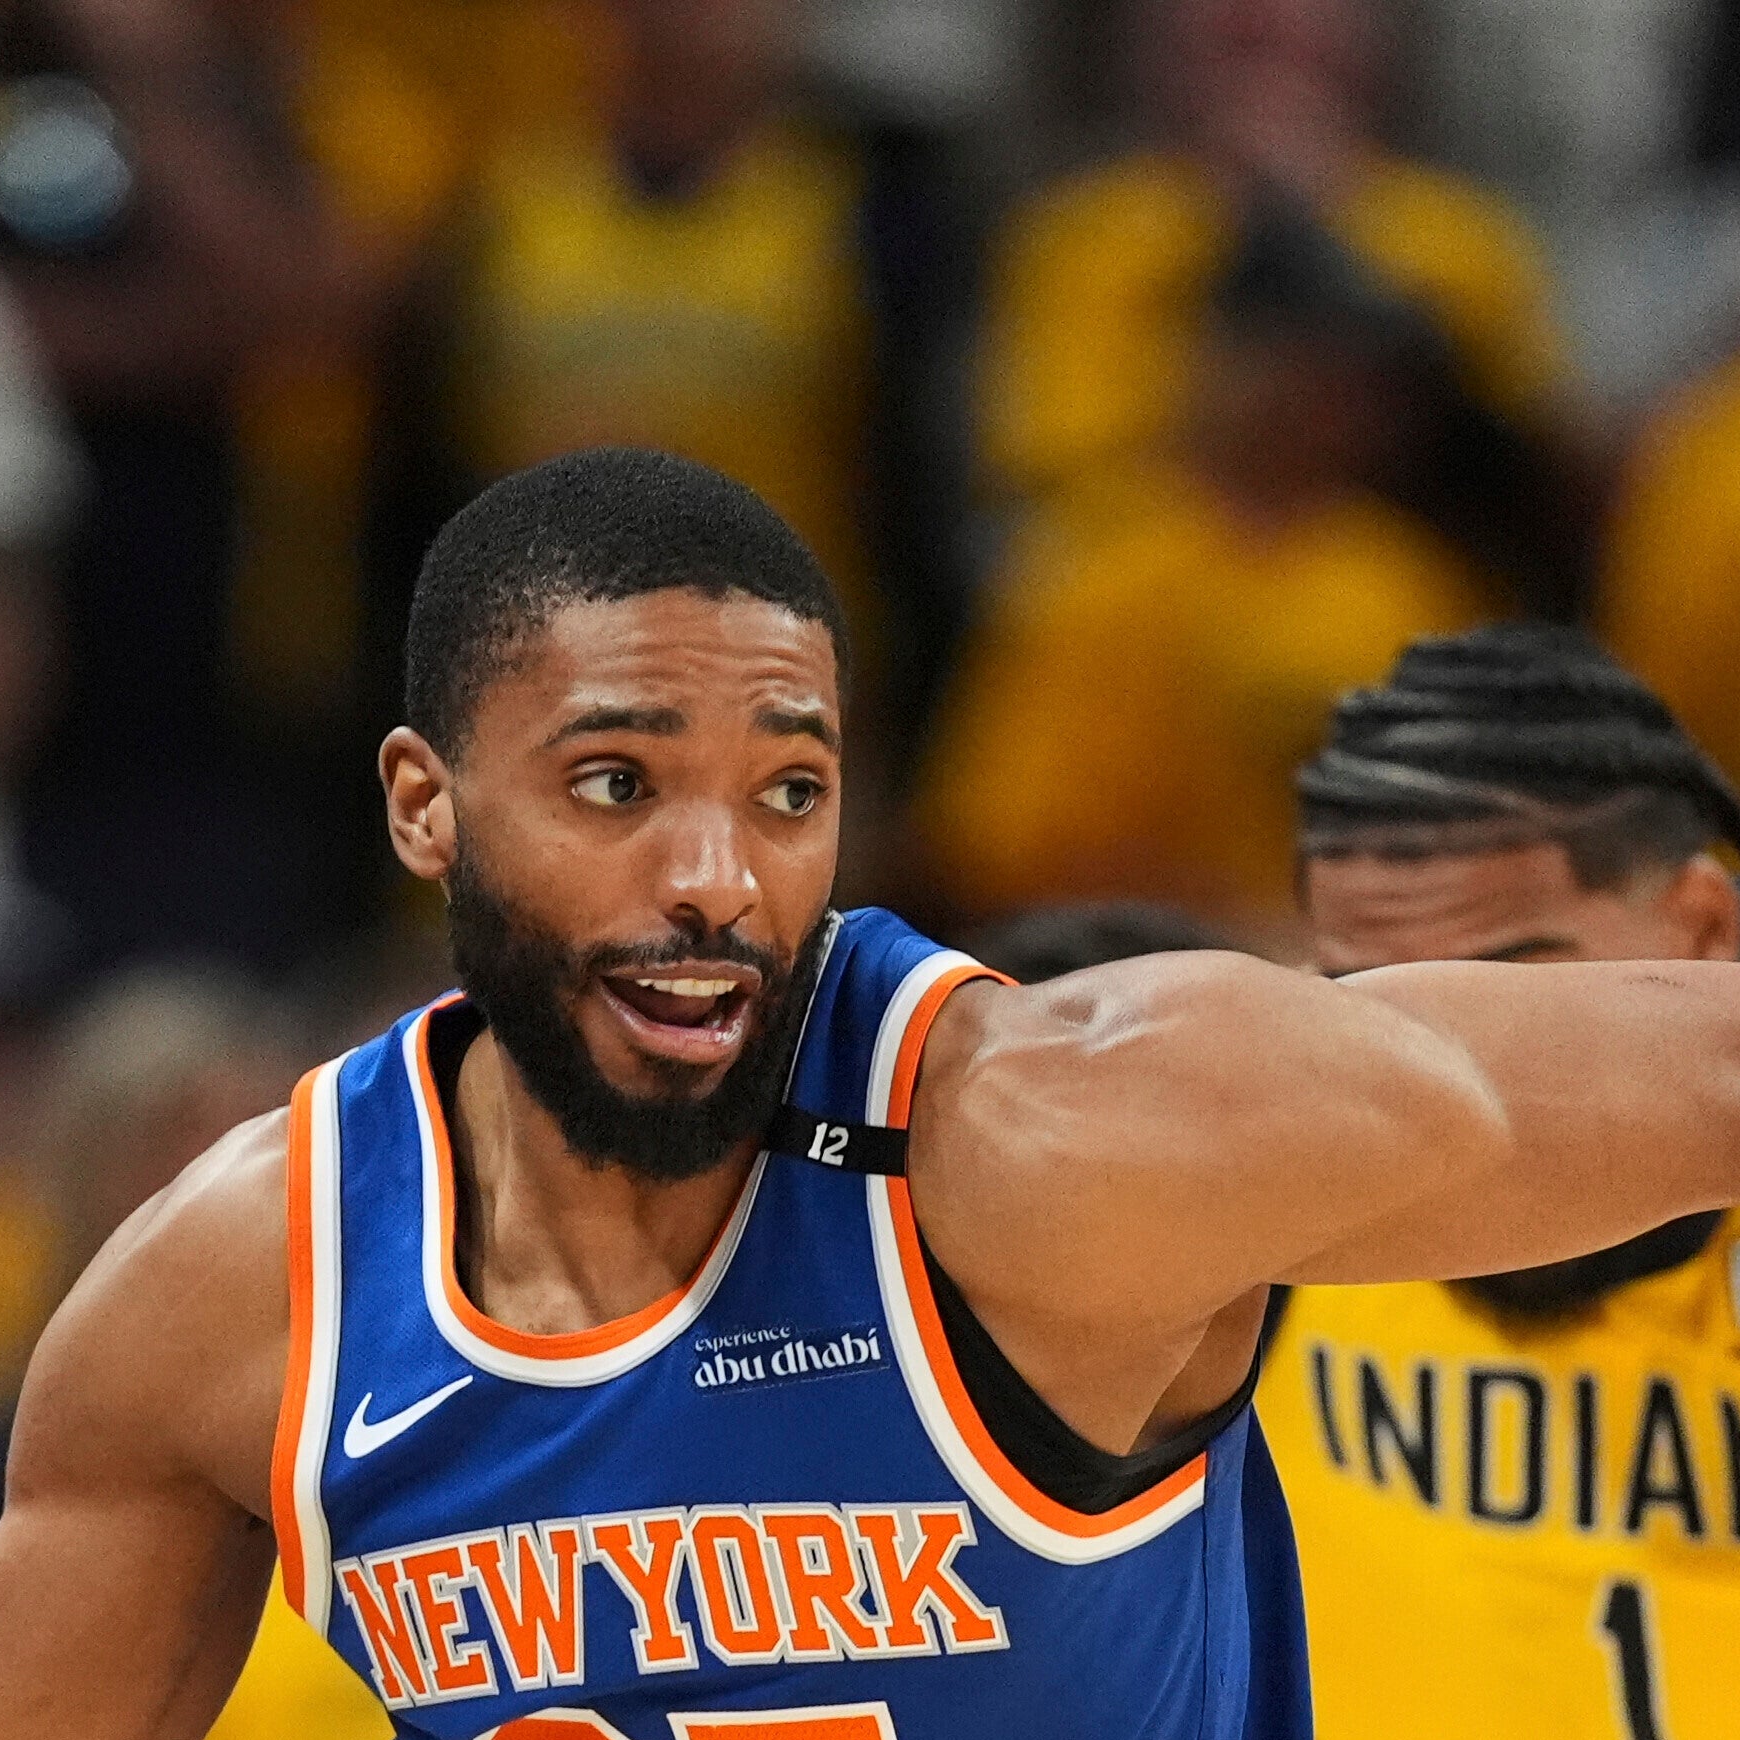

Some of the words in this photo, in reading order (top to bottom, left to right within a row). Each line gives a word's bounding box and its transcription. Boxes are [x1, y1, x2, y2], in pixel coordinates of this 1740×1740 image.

[807, 1121, 850, 1167] 12
[694, 1325, 792, 1353] experience
[694, 1353, 766, 1388] abu
[770, 1327, 882, 1377] dhabi
[335, 1518, 587, 1711] NEW
[582, 1500, 1011, 1675] YORK
